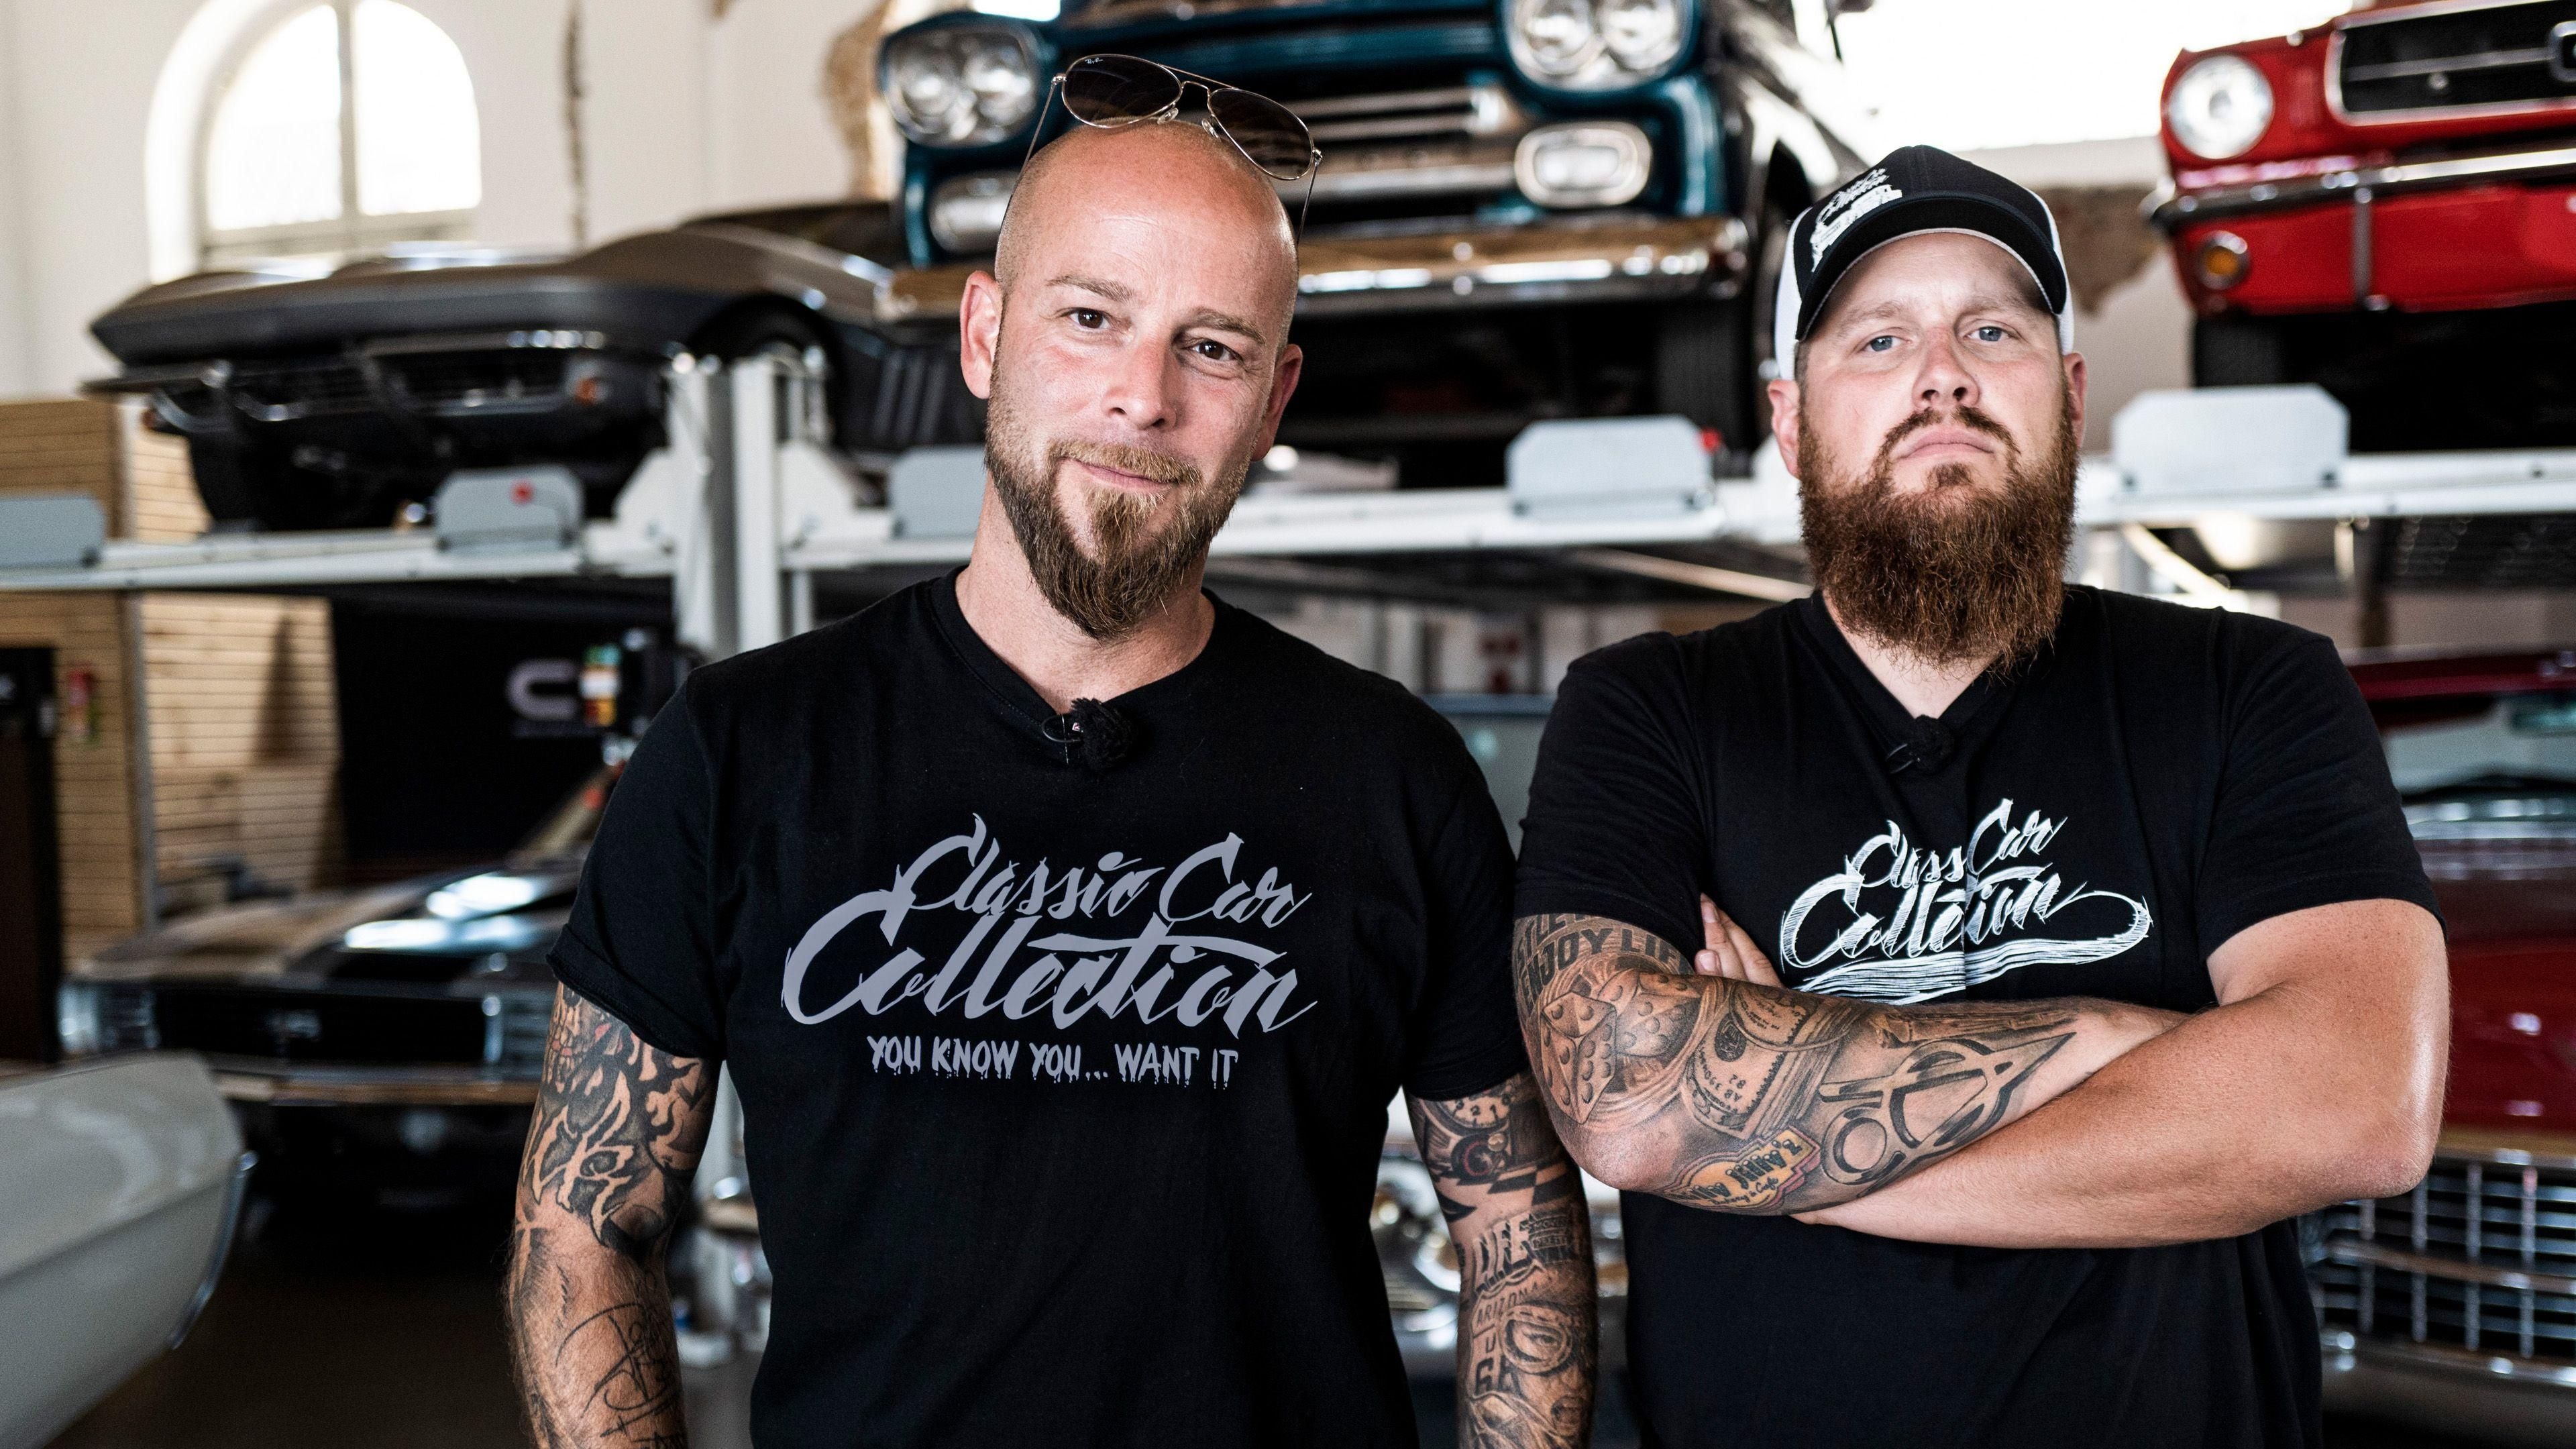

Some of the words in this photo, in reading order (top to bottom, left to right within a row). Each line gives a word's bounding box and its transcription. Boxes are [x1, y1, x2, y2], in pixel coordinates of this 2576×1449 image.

[896, 813, 1165, 920] Classic
[1159, 833, 1313, 928] Car
[1845, 820, 1966, 890] Class
[1966, 798, 2068, 875] Car
[781, 890, 1318, 1038] Collection
[867, 1035, 922, 1076] YOU
[931, 1036, 1019, 1080] KNOW
[1115, 1042, 1200, 1087] WANT
[1212, 1049, 1239, 1090] IT
